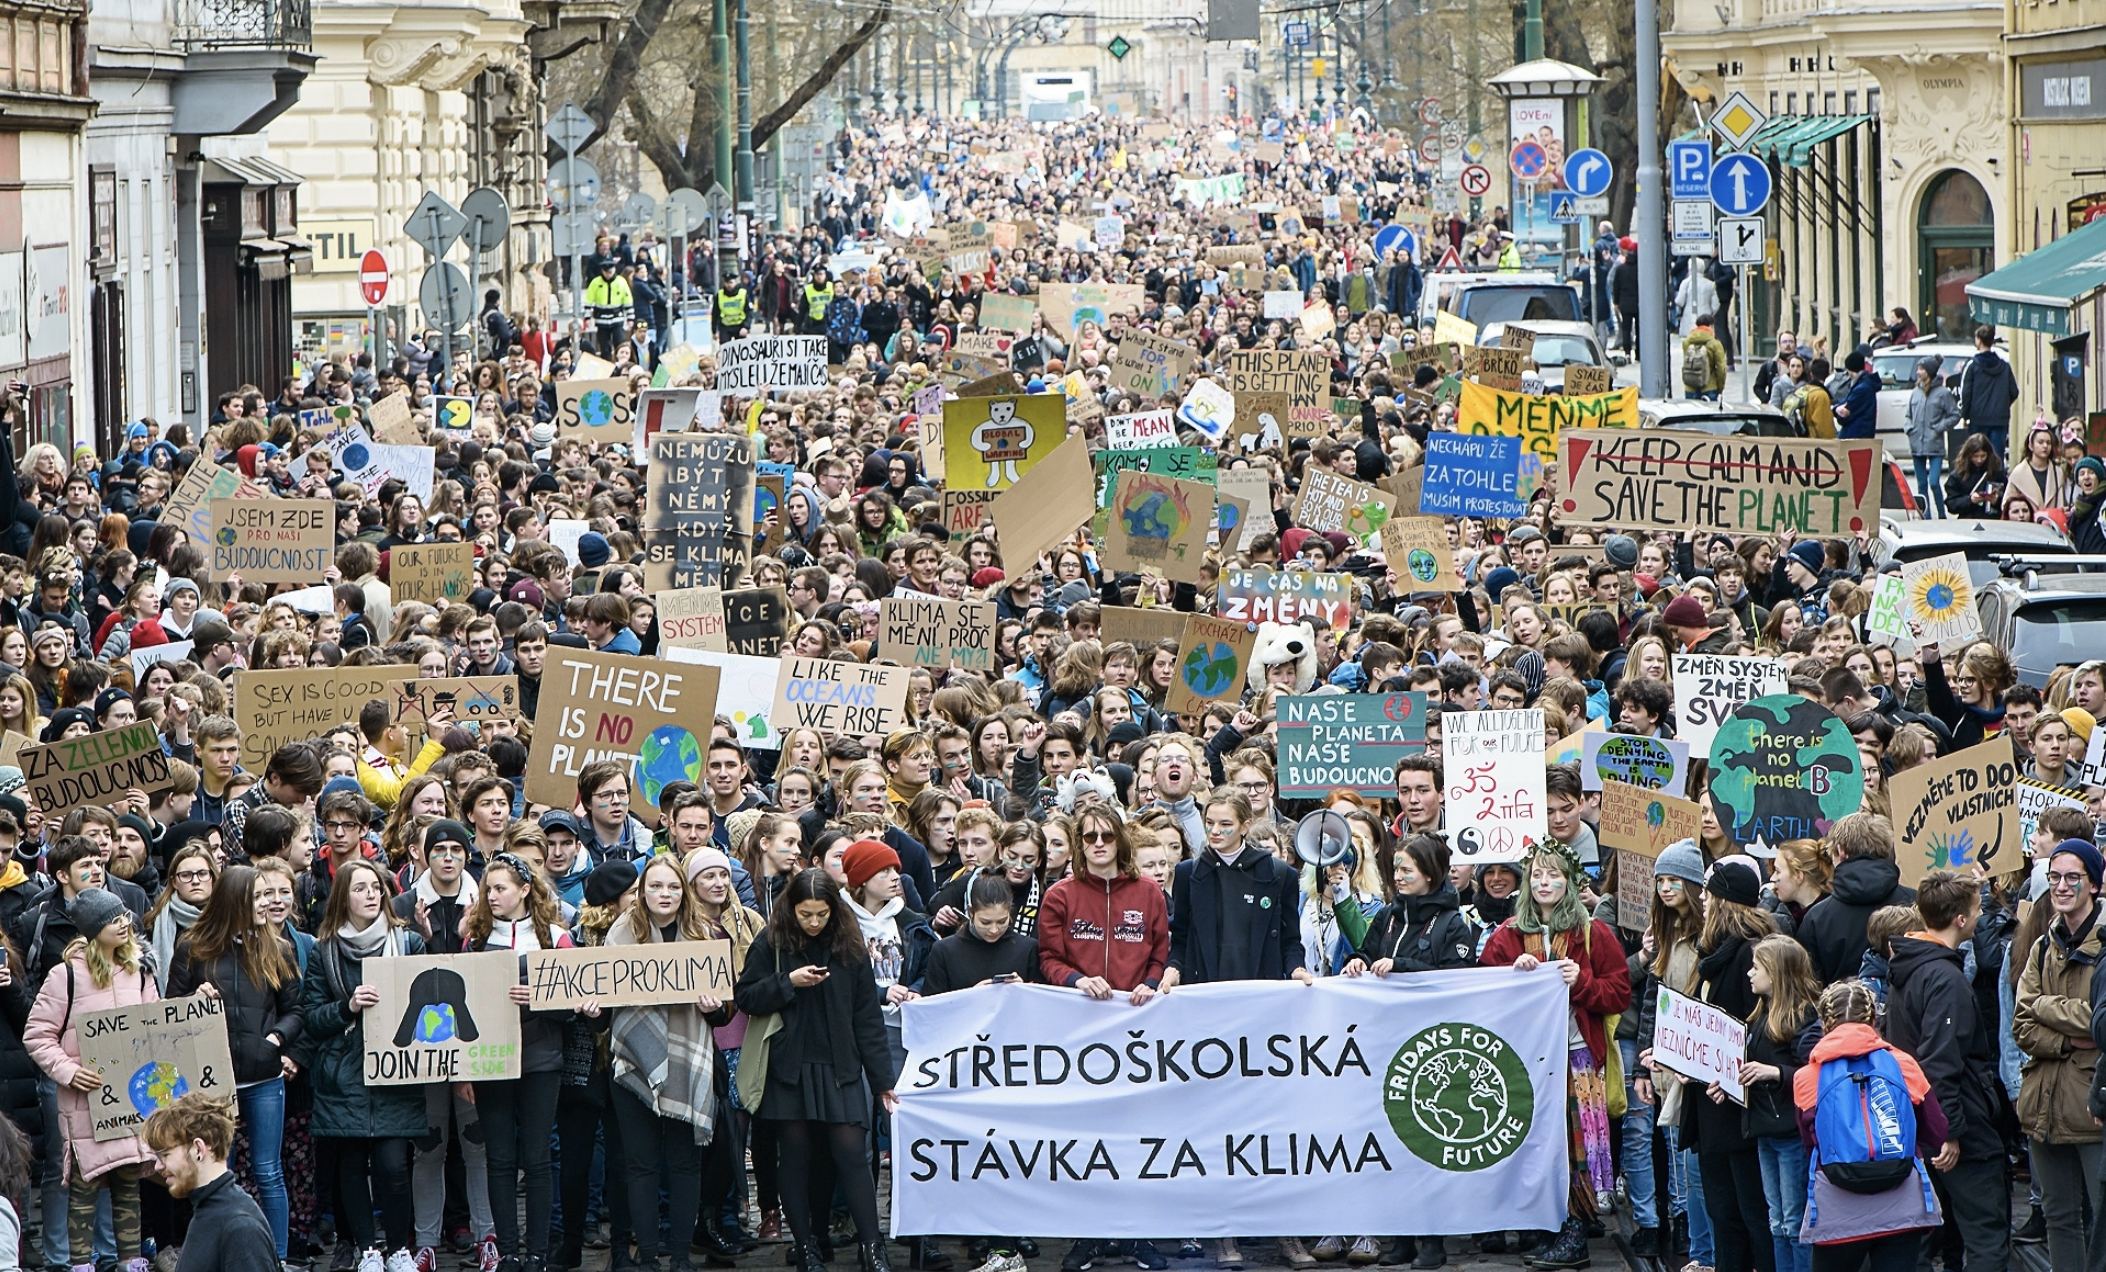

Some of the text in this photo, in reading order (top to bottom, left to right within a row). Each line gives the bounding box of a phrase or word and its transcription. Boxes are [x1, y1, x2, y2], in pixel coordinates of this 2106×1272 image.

[1924, 79, 1964, 89] OLYMPIA
[1680, 149, 1702, 181] P
[307, 233, 362, 259] TIL
[951, 250, 986, 274] MLOKY
[960, 337, 994, 349] MAKE
[1125, 330, 1147, 346] What
[1506, 325, 1534, 341] THERE
[1509, 337, 1522, 348] IS
[722, 335, 827, 368] DINOSAUŘI SI TAKÉ
[1140, 349, 1165, 364] FOR
[1232, 352, 1331, 373] THIS PLANET
[770, 359, 786, 385] ŽE
[788, 358, 810, 385] MAJÍ
[811, 358, 828, 385] ČAS
[2069, 357, 2079, 374] P
[1130, 374, 1153, 392] ON
[1234, 373, 1323, 393] IS GETTING
[1289, 394, 1316, 407] HAN
[301, 409, 334, 427] Tohle
[1133, 416, 1170, 437] MEAN
[1496, 393, 1626, 436] MĚŇME
[331, 426, 359, 456] SAVE
[983, 429, 1020, 438] GLOBAL
[1113, 441, 1134, 449] KEEP
[1116, 429, 1127, 438] BE
[659, 440, 750, 465] NEMŮŽU
[1428, 437, 1484, 458] NECHÁPU
[1489, 439, 1508, 459] ŽE
[355, 464, 380, 482] THE
[677, 462, 724, 483] BÝT
[1167, 453, 1192, 472] SE
[1595, 436, 1681, 476] KEEP
[1684, 442, 1762, 484] CALM
[1769, 444, 1840, 489] AND
[1309, 468, 1330, 490] THE
[1331, 475, 1353, 499] TEA
[1356, 486, 1369, 502] IS
[1426, 464, 1450, 483] ZA
[1451, 468, 1515, 492] TOHLE
[669, 486, 732, 510] NĚMÝ
[1306, 487, 1344, 512] HOT AND
[1423, 488, 1460, 509] MUSÍM
[1465, 497, 1529, 516] PROTESTOVAT
[1592, 476, 1672, 524] SAVE
[1674, 480, 1735, 529] THE
[1738, 488, 1849, 534] PLANET
[225, 508, 324, 530] JSEM ZDE
[677, 517, 733, 539] KDYŽ
[1323, 509, 1344, 525] OUR
[247, 528, 300, 542] PRO NAŠI
[1381, 523, 1399, 538] EVEN
[214, 547, 328, 571] BUDOUCNOST
[399, 547, 462, 568] OUR FUTURE
[650, 545, 746, 567] SE KLIMA
[420, 567, 444, 578] IS IN
[675, 565, 728, 589] MĚNÍ
[1229, 571, 1338, 592] JE ČAS NA
[1905, 559, 1932, 582] THERE
[396, 576, 470, 601] YOUR HANDS
[727, 598, 770, 624] ÍCE
[889, 602, 983, 629] KLIMA SE
[1226, 592, 1339, 625] ZMĚNY
[663, 613, 724, 639] SYSTÉM
[888, 622, 991, 650] MĚNÍ, PROČ
[1193, 620, 1247, 645] DOCHÁZÍ
[1919, 610, 1978, 640] PLANET B
[914, 646, 941, 665] NE
[792, 661, 889, 686] LIKE THE
[1677, 656, 1787, 683] ZMĚŇ SYSTÉM
[253, 679, 383, 709] SEX IS GOOD
[561, 659, 683, 714] THERE
[785, 679, 877, 708] OCEANS
[255, 707, 332, 728] BUT HAVE
[795, 702, 894, 735] WE RISE
[1288, 700, 1356, 722] NAŠE
[1446, 713, 1469, 733] WE
[558, 706, 634, 746] IS NO
[1312, 724, 1405, 742] PLANETA
[1747, 723, 1824, 749] there is
[21, 725, 159, 781] ZA ZELENOU
[1288, 742, 1351, 763] NAŠE
[1451, 731, 1544, 756] FOR FUTURE
[1607, 746, 1666, 760] DENYING
[1621, 739, 1649, 748] STOP
[1634, 758, 1669, 768] EARTH
[1767, 752, 1791, 767] no
[1289, 766, 1394, 785] BUDOUCNO
[1743, 765, 1831, 795] planet B
[1902, 762, 2015, 845] VEZMĚME TO DO
[1947, 782, 2015, 825] VLASTNÍCH
[1735, 810, 1811, 842] EARTH
[85, 997, 224, 1038] SAVE THE PLANET
[467, 1043, 516, 1059] GREEN
[912, 1024, 1372, 1089] STŘEDOŠKOLSKÁ
[1656, 1025, 1735, 1081] NEZNIČME SI HO
[367, 1048, 459, 1080] JOIN THE
[471, 1059, 506, 1076] SIDE
[1389, 1027, 1503, 1100] FRIDAYS FOR
[96, 1112, 145, 1131] ANIMALS
[1869, 1077, 1904, 1155] PUMA
[1442, 1116, 1524, 1165] FUTURE
[910, 1128, 1393, 1182] STÁVKA ZA KLIMA
